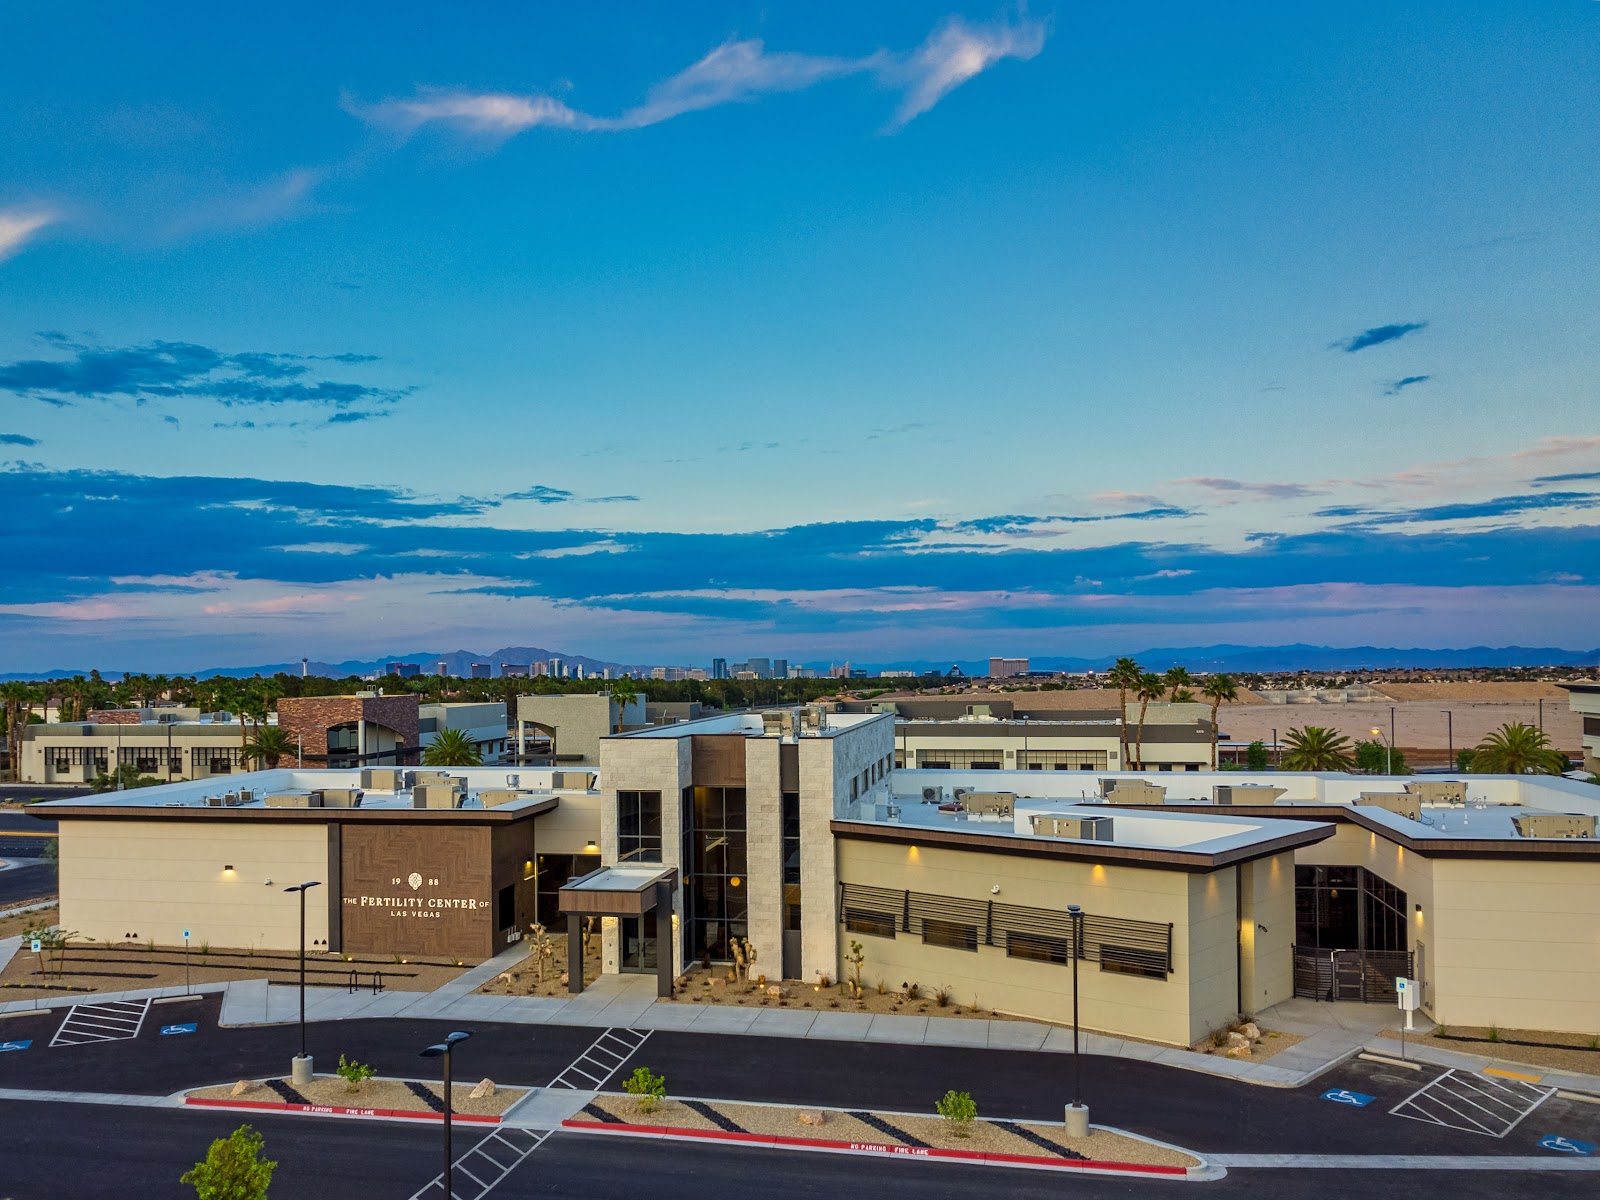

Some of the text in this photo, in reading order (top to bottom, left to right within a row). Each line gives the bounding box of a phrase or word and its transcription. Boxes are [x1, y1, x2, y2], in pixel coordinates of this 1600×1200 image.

[391, 877, 439, 886] 19 88
[343, 897, 358, 905] THE
[360, 896, 424, 908] FERTILITY
[427, 898, 477, 910] CENTER
[861, 1144, 887, 1152] PARKING
[894, 1146, 909, 1154] FIRE
[912, 1148, 929, 1156] LANE
